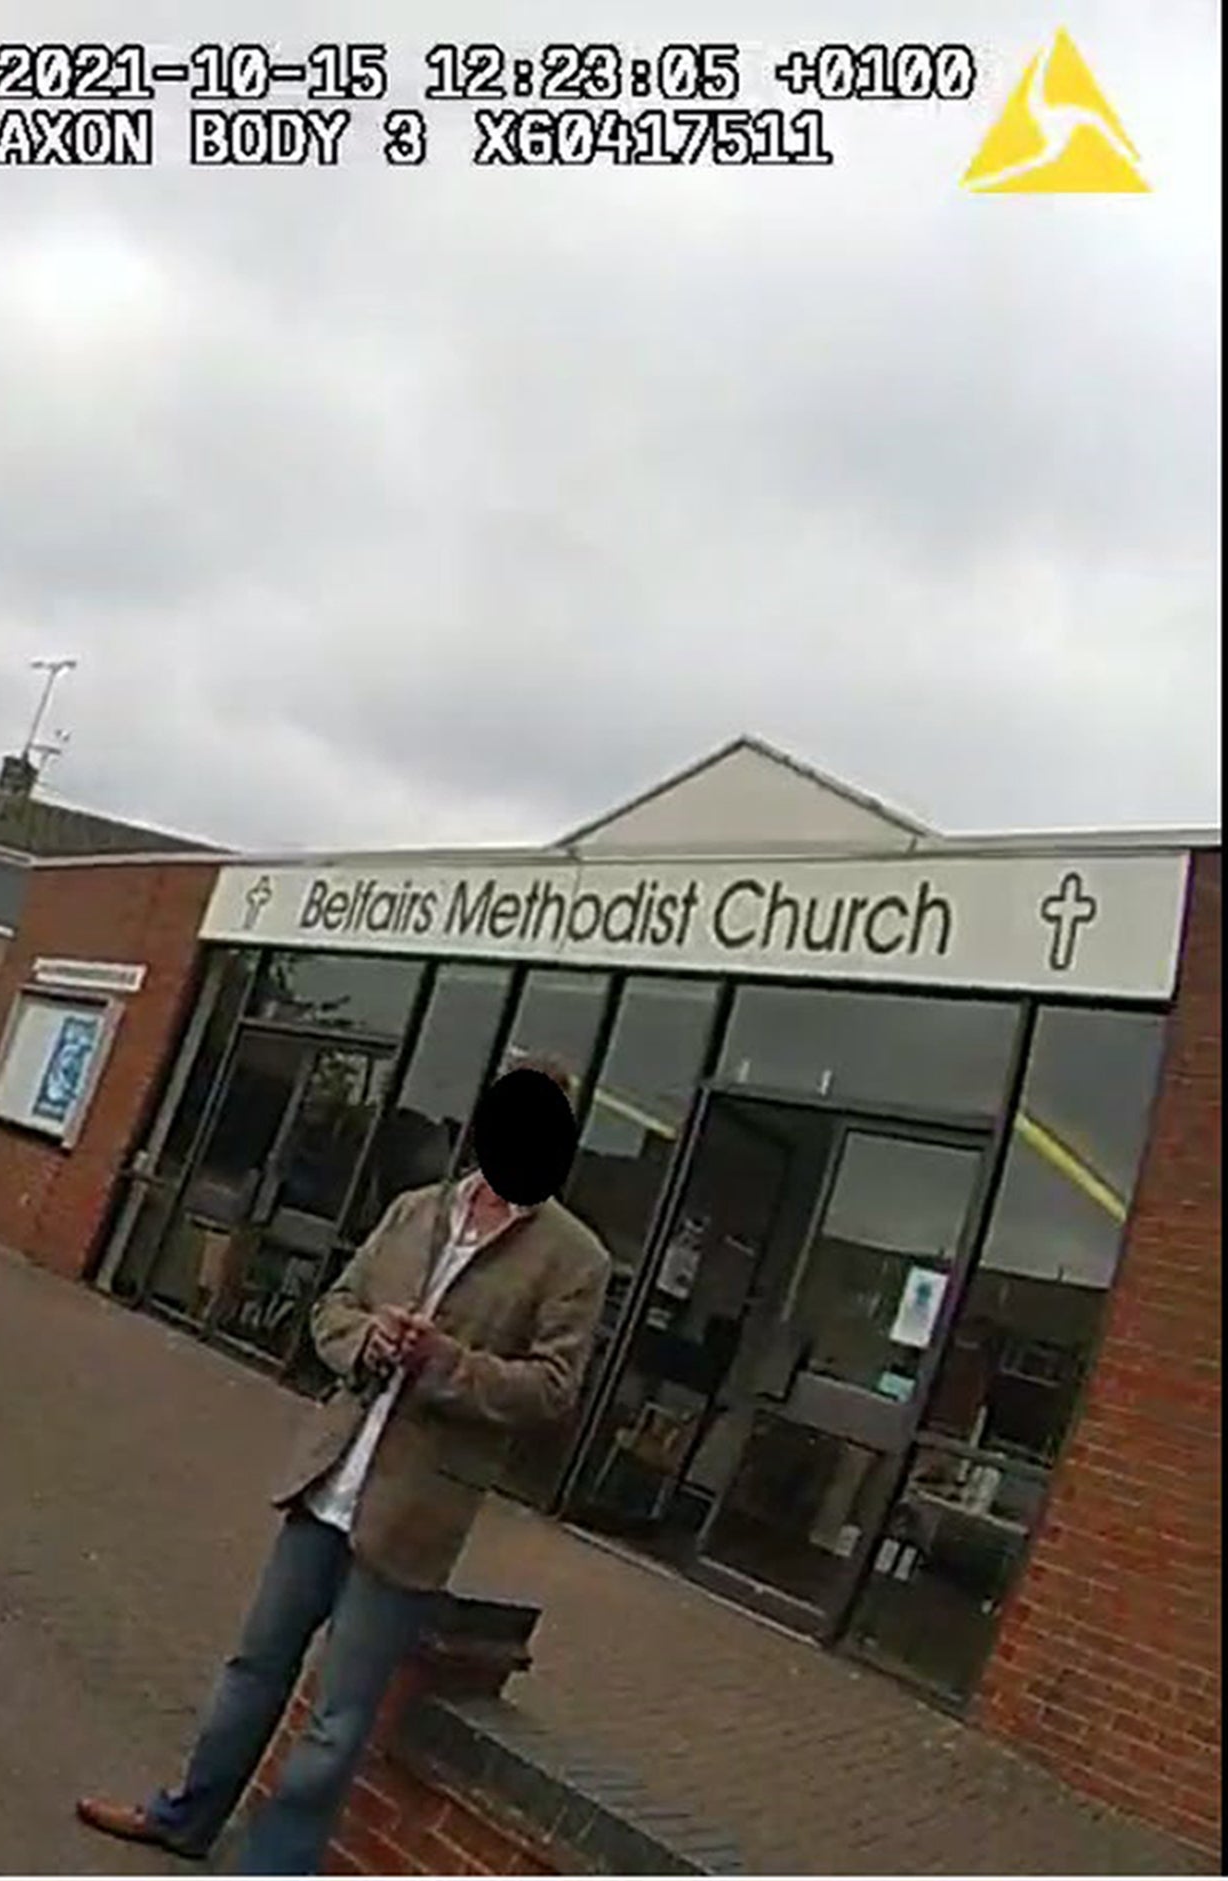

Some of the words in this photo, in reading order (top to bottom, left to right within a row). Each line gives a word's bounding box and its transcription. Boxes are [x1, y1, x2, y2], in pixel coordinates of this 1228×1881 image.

[300, 880, 437, 934] Belfairs
[444, 881, 698, 947] Methodist
[713, 879, 952, 955] Church
